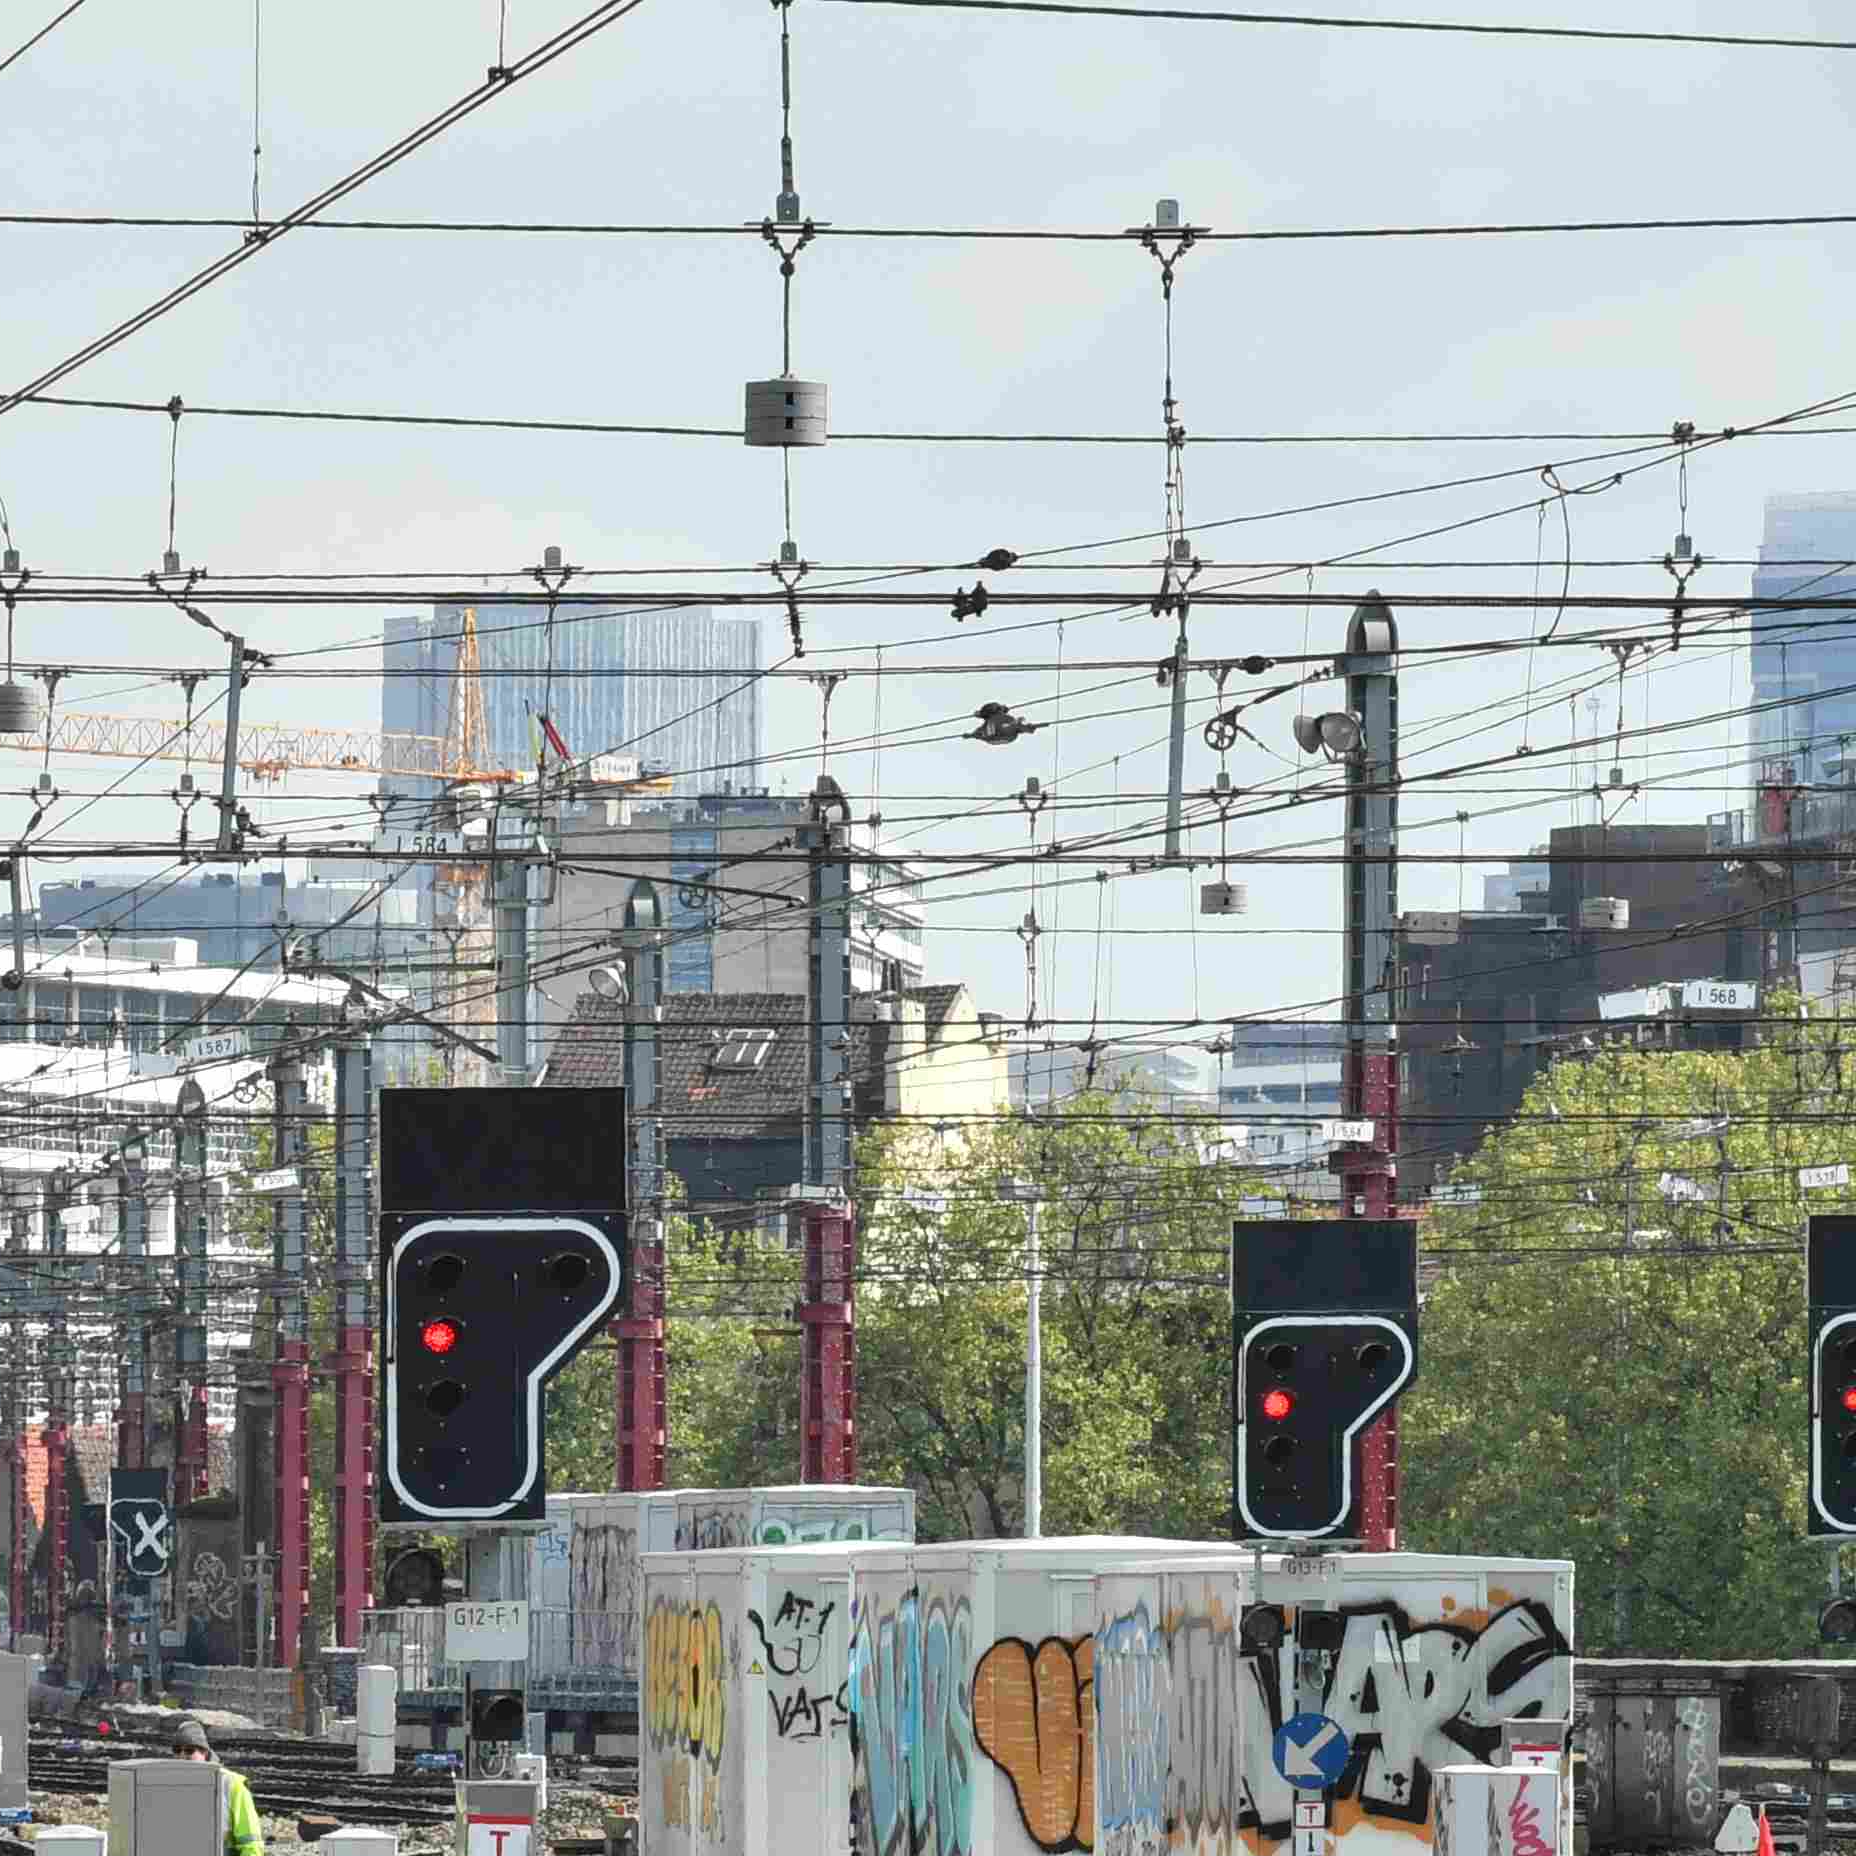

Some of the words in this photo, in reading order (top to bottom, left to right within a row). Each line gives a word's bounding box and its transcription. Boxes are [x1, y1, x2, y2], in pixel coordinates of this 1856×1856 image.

[413, 836, 447, 853] 584
[1710, 988, 1737, 1005] 568
[1303, 1805, 1319, 1824] T
